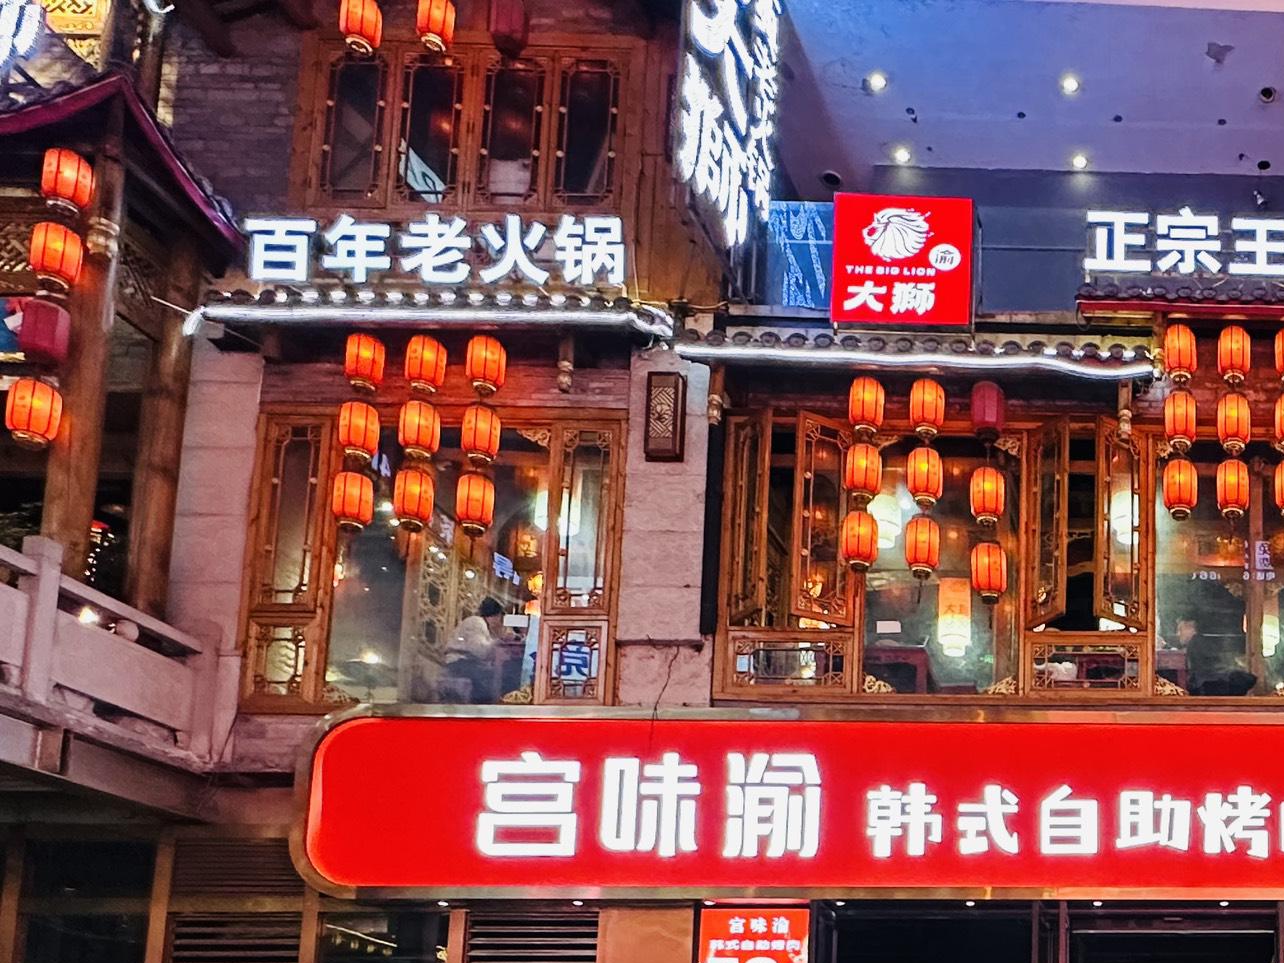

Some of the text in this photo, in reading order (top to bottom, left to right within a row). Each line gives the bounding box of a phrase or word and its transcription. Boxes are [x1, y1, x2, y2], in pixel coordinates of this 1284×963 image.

[245, 214, 626, 284] 百年老火锅
[846, 265, 874, 275] THE
[903, 267, 936, 277] LION
[477, 751, 822, 858] 宫味渝
